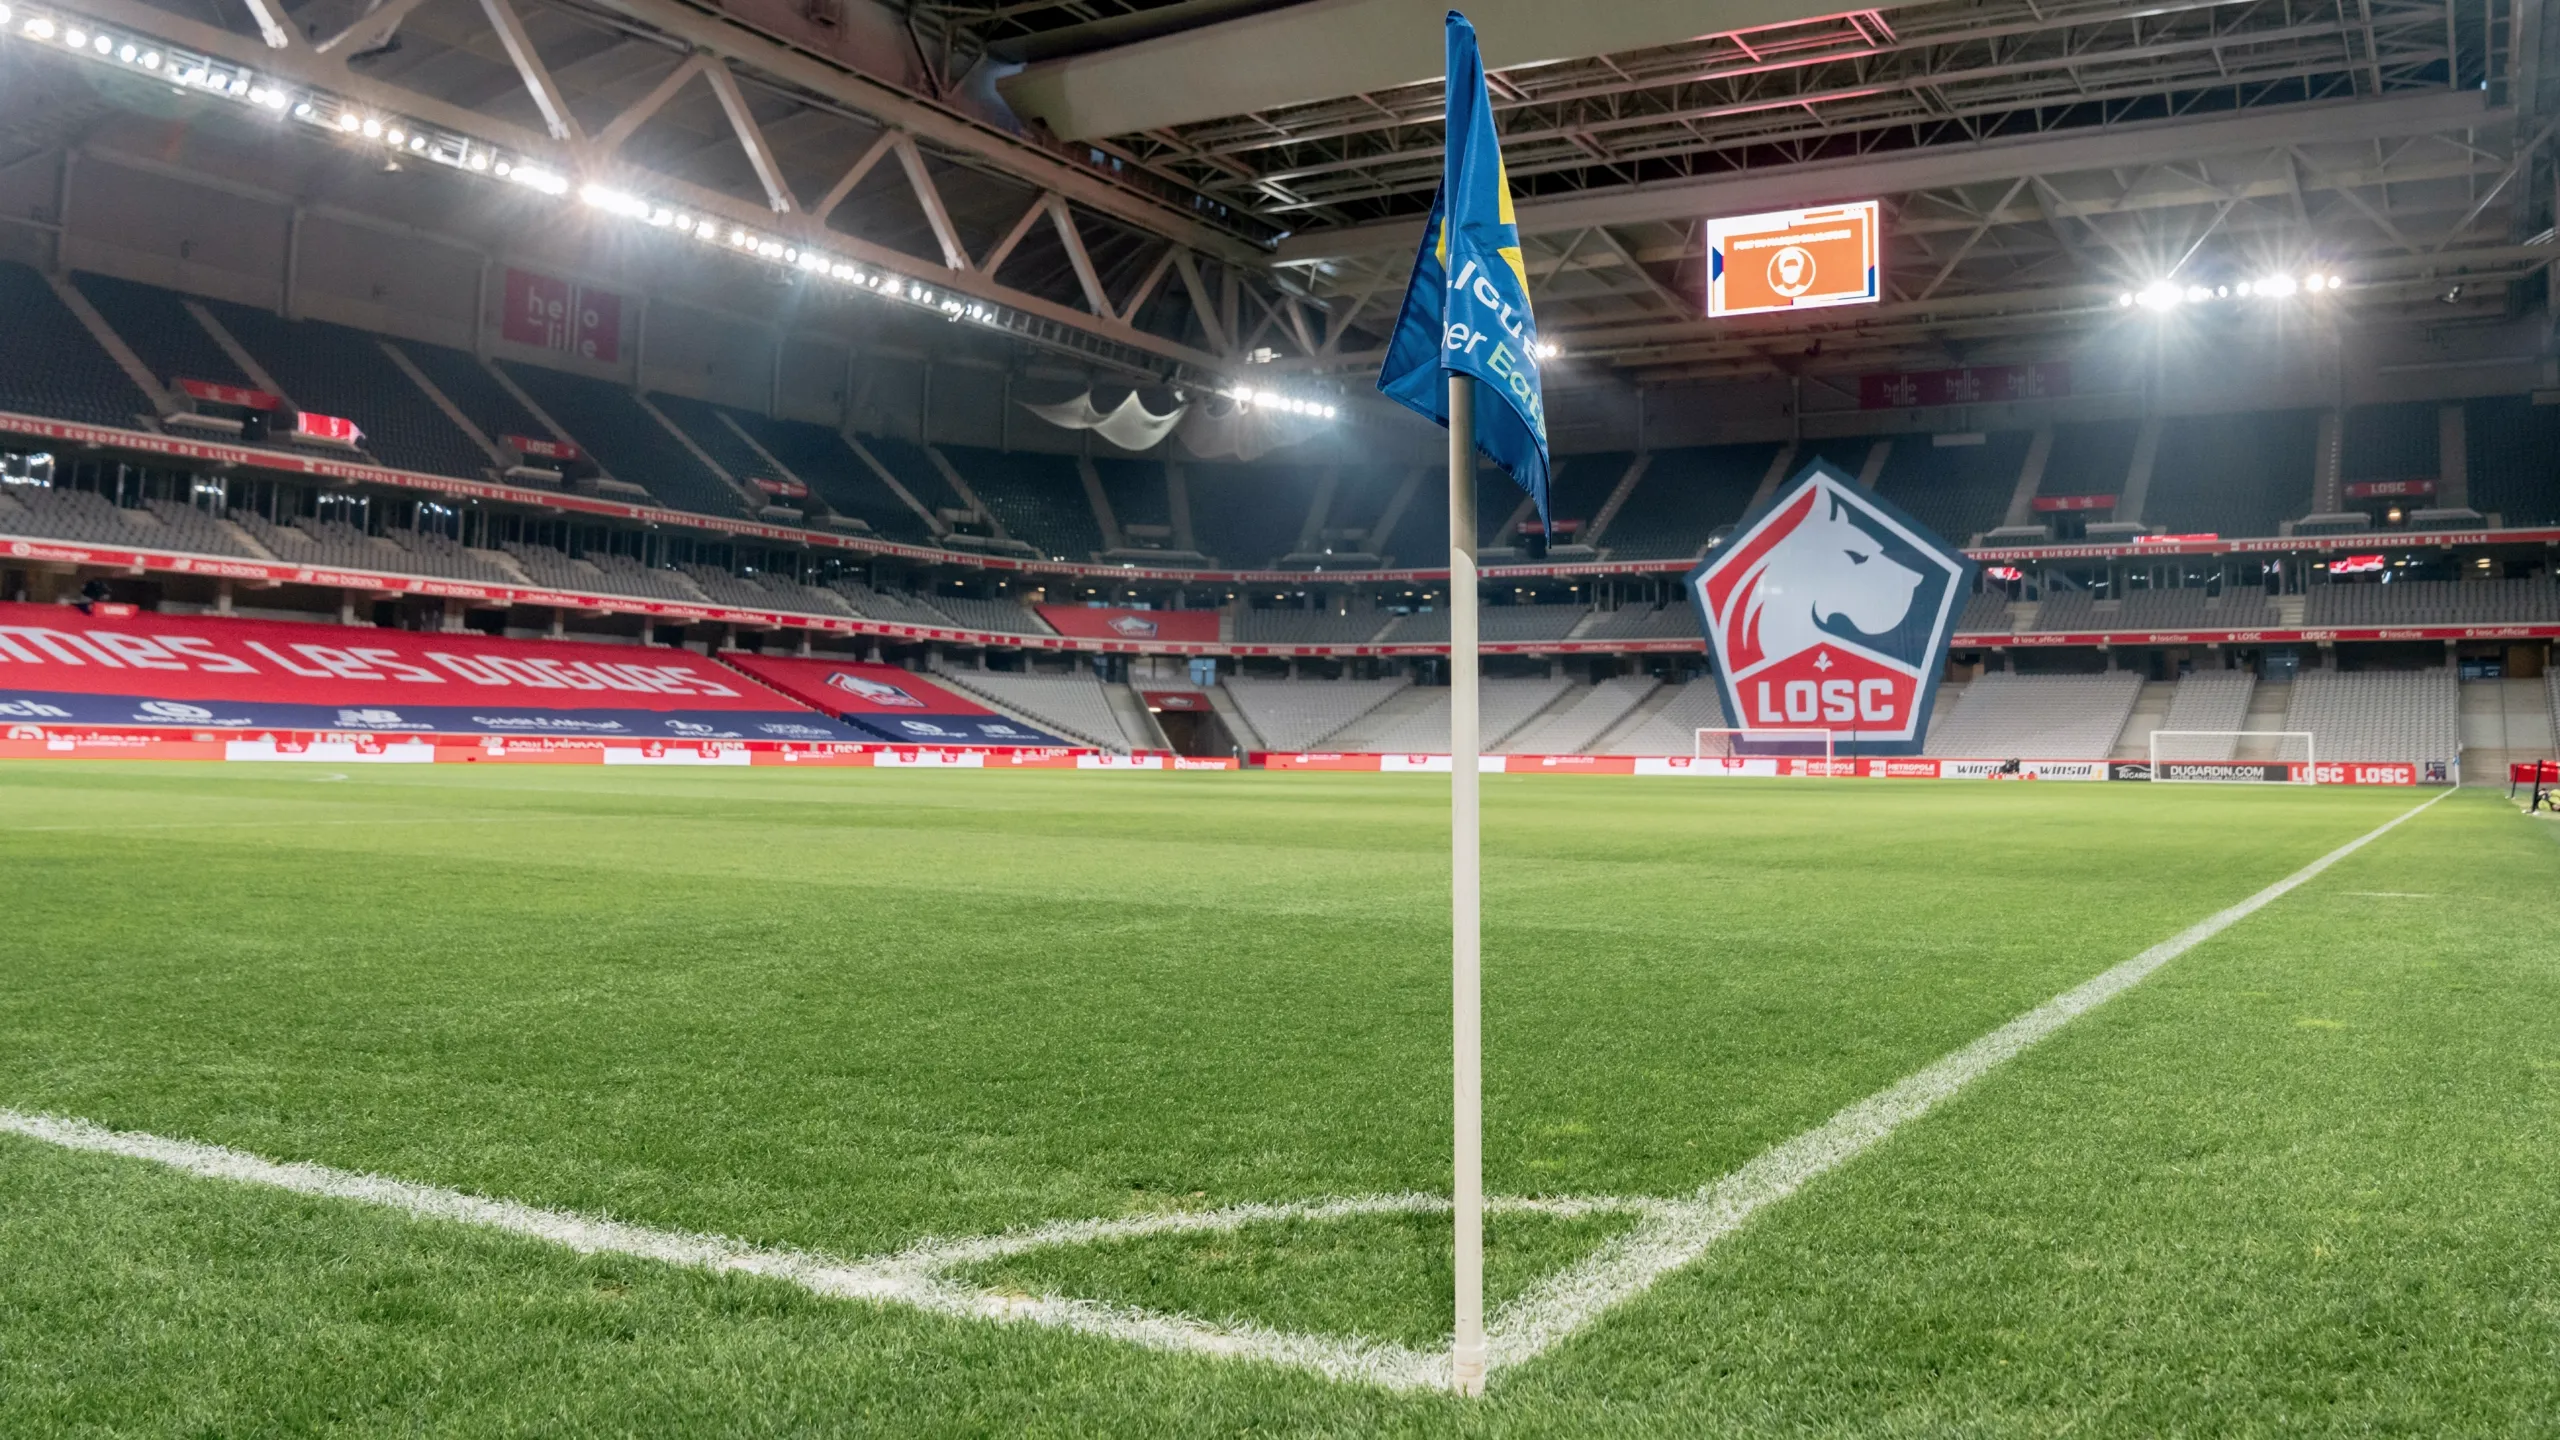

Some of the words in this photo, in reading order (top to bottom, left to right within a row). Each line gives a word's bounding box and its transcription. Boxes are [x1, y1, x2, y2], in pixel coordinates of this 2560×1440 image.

[527, 283, 599, 330] hello
[1447, 260, 1537, 370] IGUE
[178, 443, 199, 456] DE
[208, 448, 249, 463] LILLE
[2371, 481, 2407, 494] LOSC
[492, 488, 506, 500] DE
[512, 492, 544, 505] LILLE
[2247, 540, 2322, 550] MÉTROPOLE
[2330, 536, 2417, 548] EUROPÉENNE
[2425, 535, 2442, 544] DE
[2450, 534, 2488, 544] LILLE
[1968, 551, 2034, 560] MÉTROPOLE
[2042, 548, 2118, 558] EUROPÉENNE
[2126, 546, 2141, 555] DE
[2148, 545, 2182, 555] LILLE
[195, 563, 220, 575] new
[221, 564, 268, 577] balance
[317, 573, 339, 584] new
[340, 574, 383, 588] balance
[1950, 637, 1977, 646] osclive
[2238, 632, 2262, 641] LOSC
[2301, 631, 2338, 640] LOSC.fr
[0, 625, 261, 675] MES
[1757, 679, 1895, 723] LOSC
[2039, 764, 2093, 776] winsol
[2170, 766, 2265, 776] DUGARDIN.COM
[2355, 767, 2409, 784] LOSC
